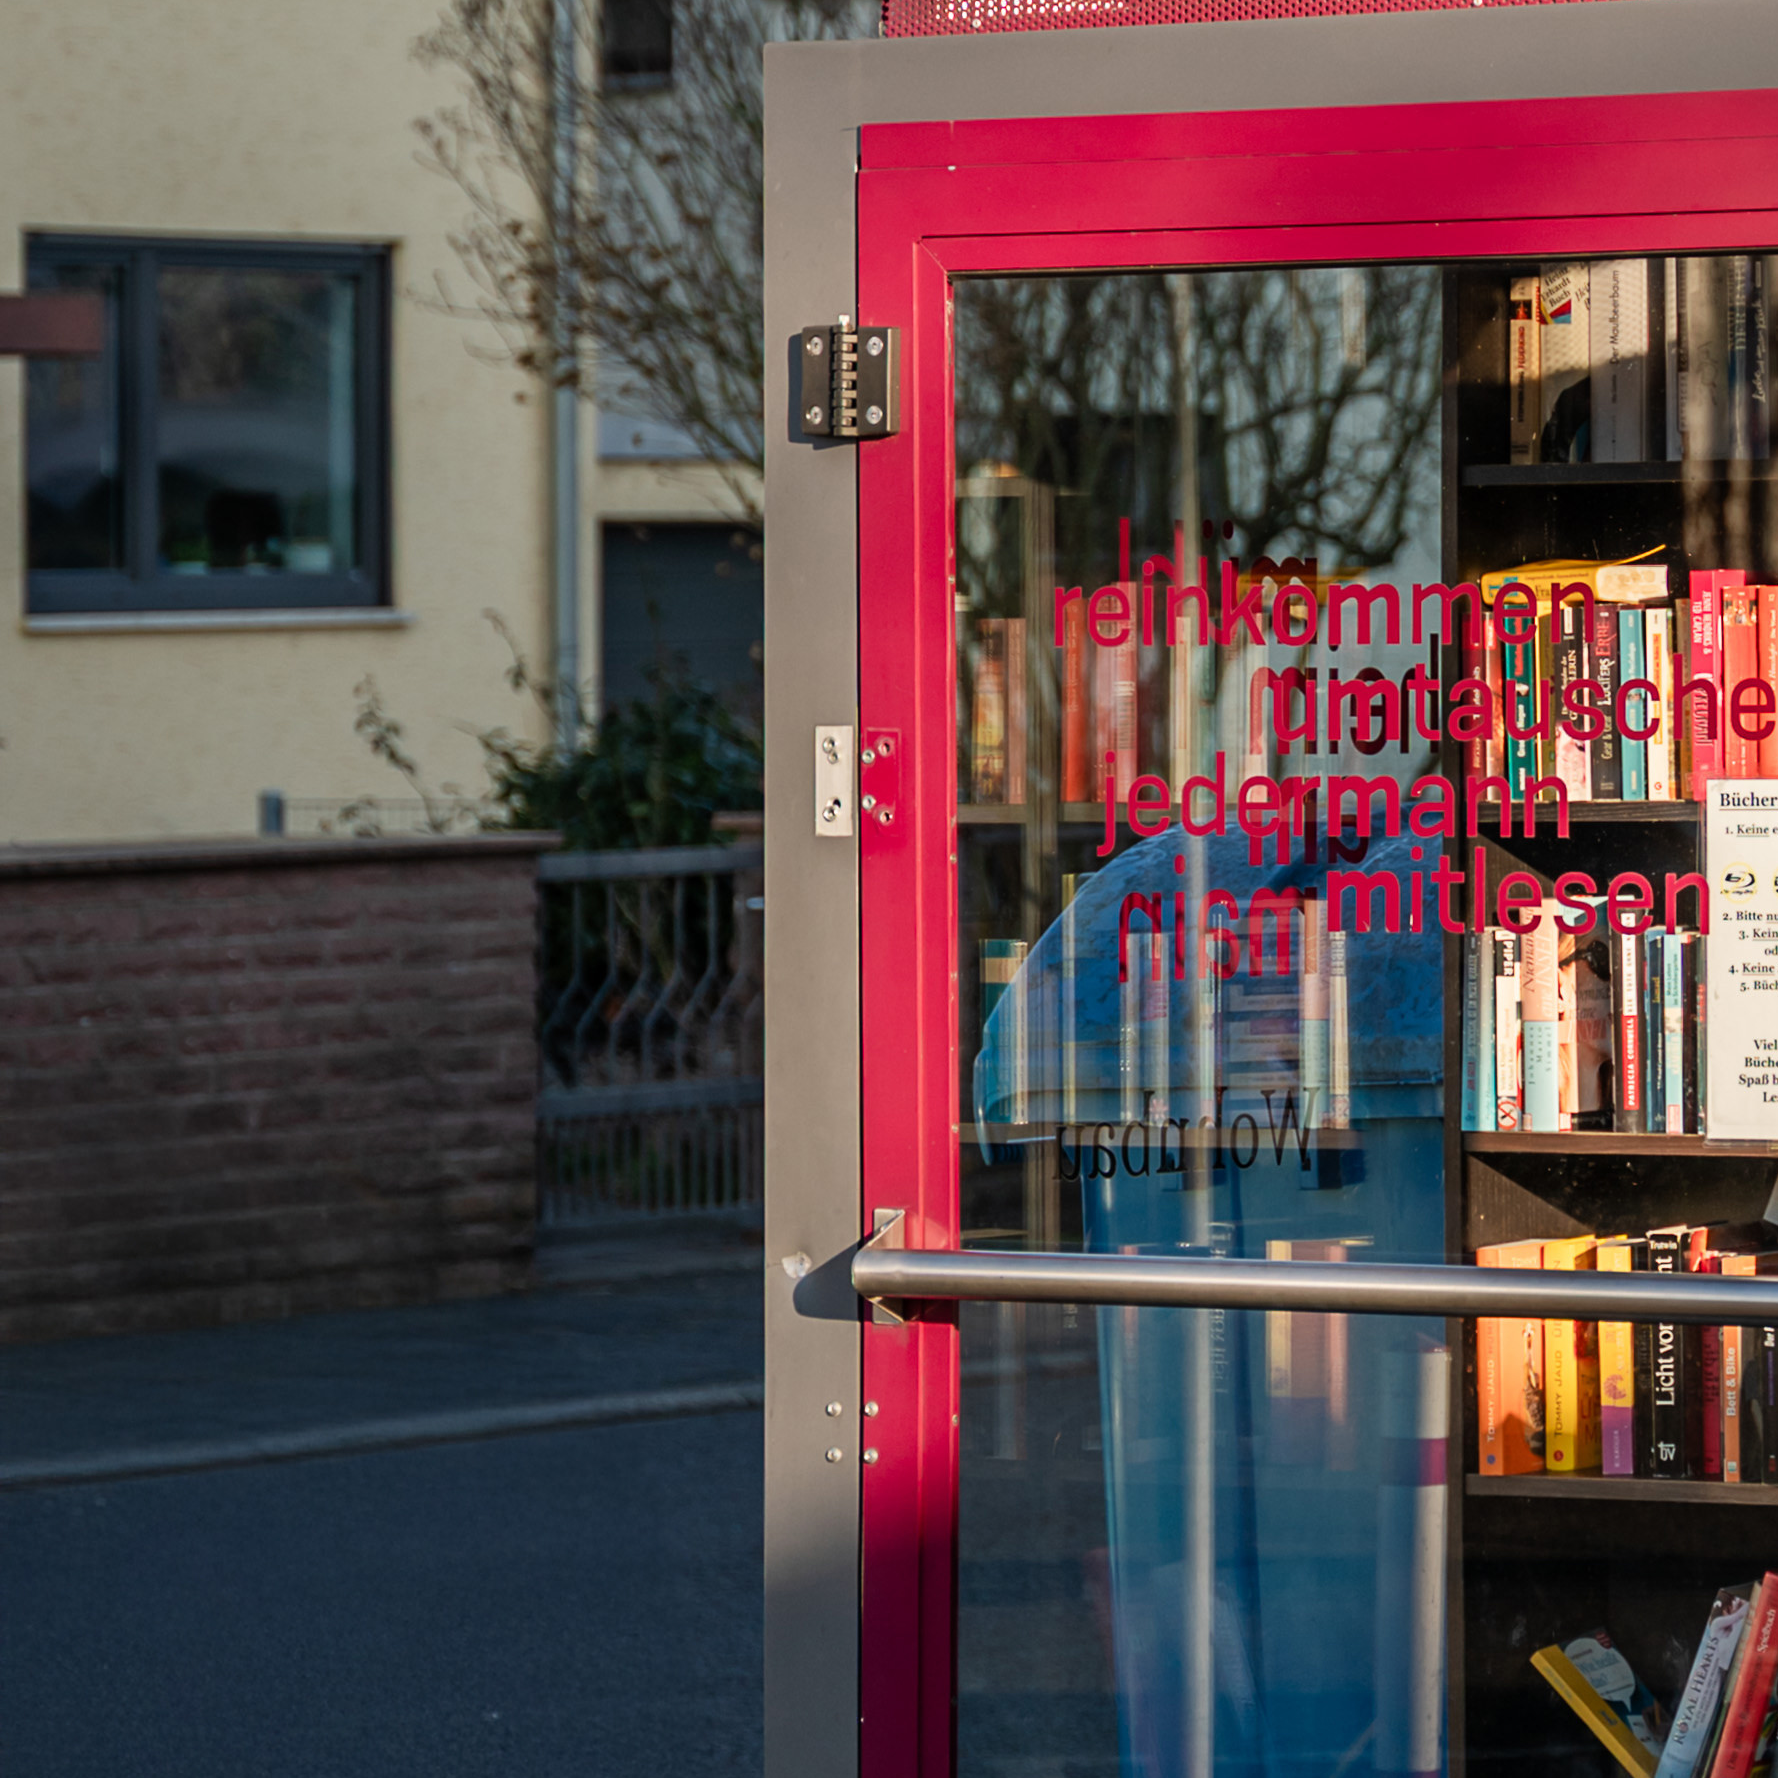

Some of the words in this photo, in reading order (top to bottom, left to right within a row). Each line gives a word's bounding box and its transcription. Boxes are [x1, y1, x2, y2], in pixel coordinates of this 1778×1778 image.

[1609, 270, 1620, 345] Maulbeerbaum
[1610, 347, 1619, 365] Der
[1054, 560, 1597, 647] reinkommen
[1692, 601, 1702, 614] TED
[1702, 590, 1712, 612] JENNI
[1595, 621, 1617, 656] ERBE
[1692, 616, 1702, 644] CAPLAN
[1597, 658, 1615, 705] LUCIFERS
[1097, 750, 1570, 857] jedermann
[1725, 826, 1734, 835] 1.
[1737, 824, 1770, 835] Keine
[1327, 846, 1711, 935] mitlesen
[1722, 912, 1732, 922] 2.
[1736, 911, 1763, 921] Bitte
[1738, 930, 1749, 940] 3.
[1502, 940, 1513, 976] PIPER
[1536, 931, 1552, 987] INSEL
[1728, 965, 1739, 975] 4.
[1742, 963, 1775, 974] Keine
[1740, 982, 1750, 992] 5.
[1627, 1018, 1636, 1060] CORNWELL
[1628, 1064, 1636, 1106] PATRICIA
[1738, 1074, 1769, 1087] Spaß
[1486, 1359, 1495, 1395] JAUD
[1553, 1350, 1563, 1387] JAUD
[1726, 1347, 1735, 1375] Bike
[1656, 1357, 1676, 1406] Licht
[1486, 1399, 1495, 1442] TOMMY
[1553, 1393, 1563, 1437] TOMMY
[1726, 1391, 1736, 1416] Bett
[1756, 1608, 1777, 1654] Spielbuch
[1672, 1686, 1703, 1745] ROYAL
[1691, 1635, 1720, 1688] HEARTS
